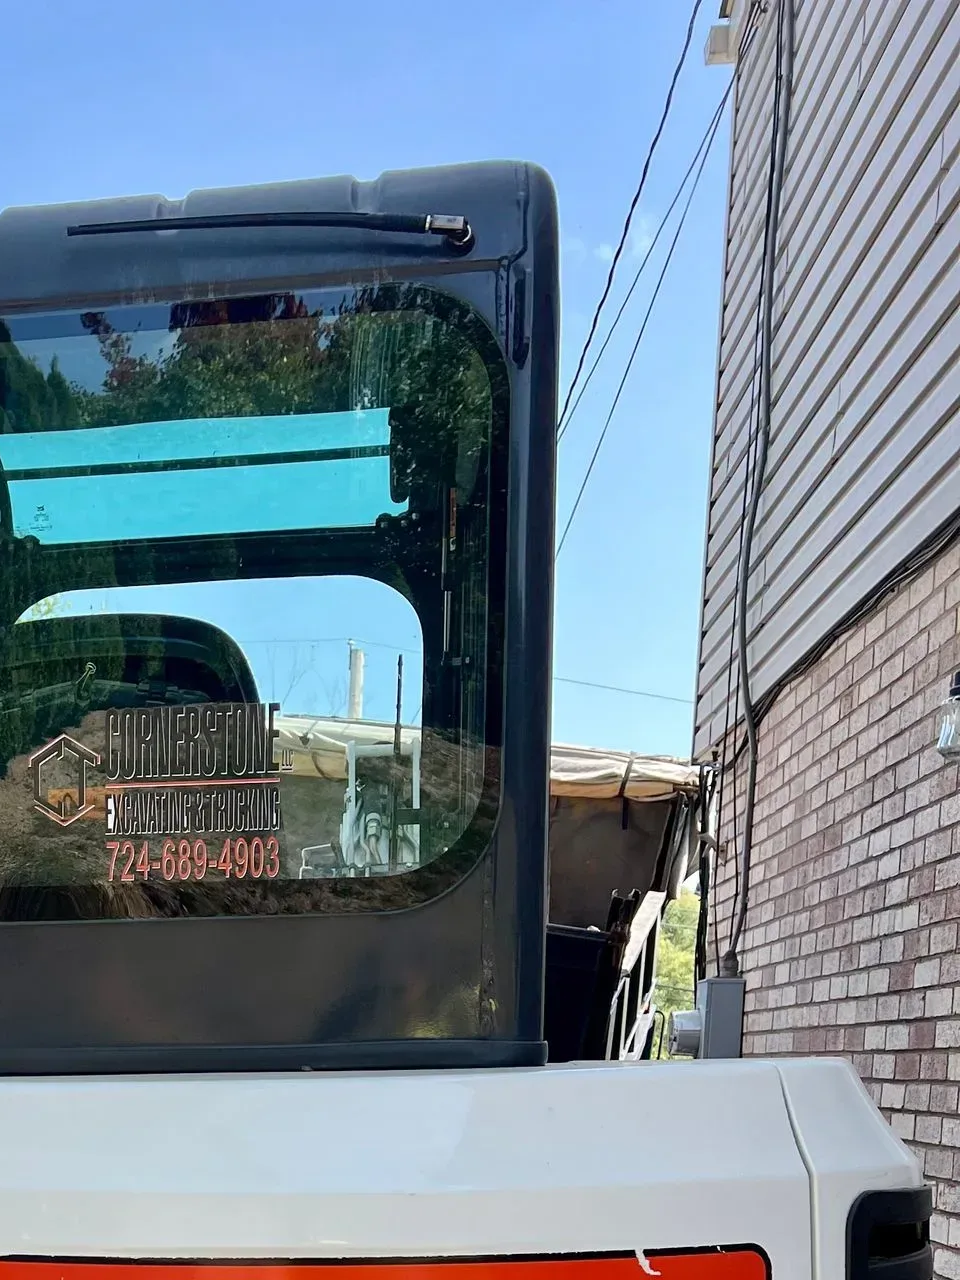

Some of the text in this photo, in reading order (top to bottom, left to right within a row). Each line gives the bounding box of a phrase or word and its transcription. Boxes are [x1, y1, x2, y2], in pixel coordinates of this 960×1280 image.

[104, 702, 281, 780] CORNERSTONE
[105, 787, 281, 835] EXCAVATING & TRUCKING
[105, 836, 281, 882] 724-689-4903
